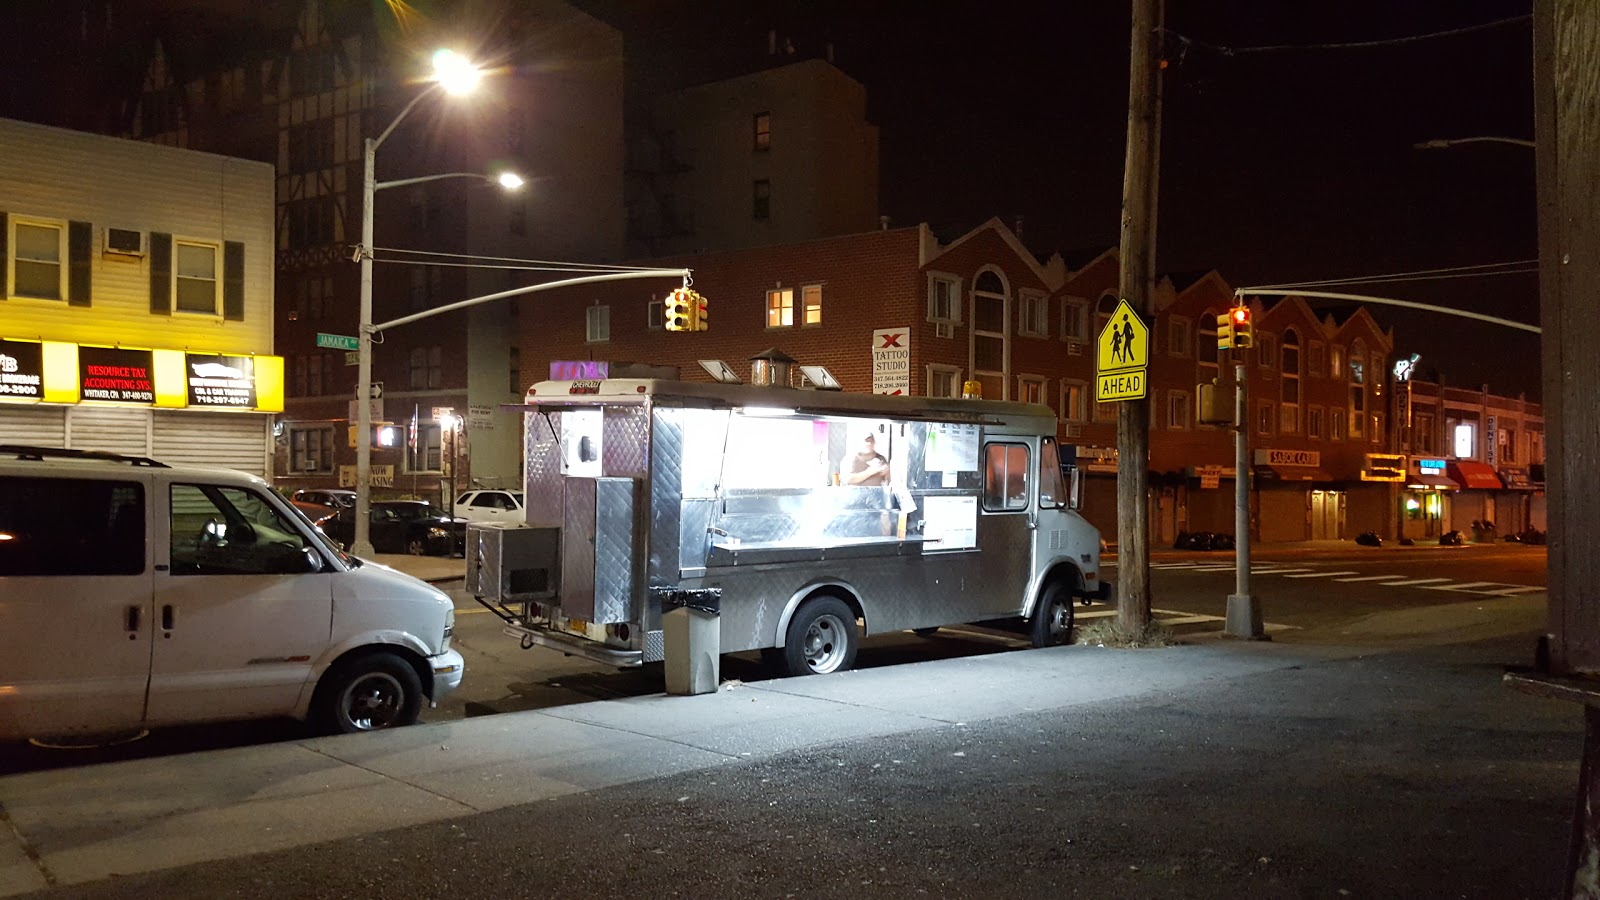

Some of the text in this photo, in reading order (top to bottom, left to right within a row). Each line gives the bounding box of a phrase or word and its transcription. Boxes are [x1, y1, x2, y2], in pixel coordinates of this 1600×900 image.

[319, 335, 349, 347] JAMAICA
[875, 350, 908, 360] TATTOO
[88, 365, 146, 378] RESOURCE TAX
[876, 361, 907, 371] STUDIO
[84, 377, 135, 390] ACCOUNTING
[1102, 376, 1140, 394] AHEAD
